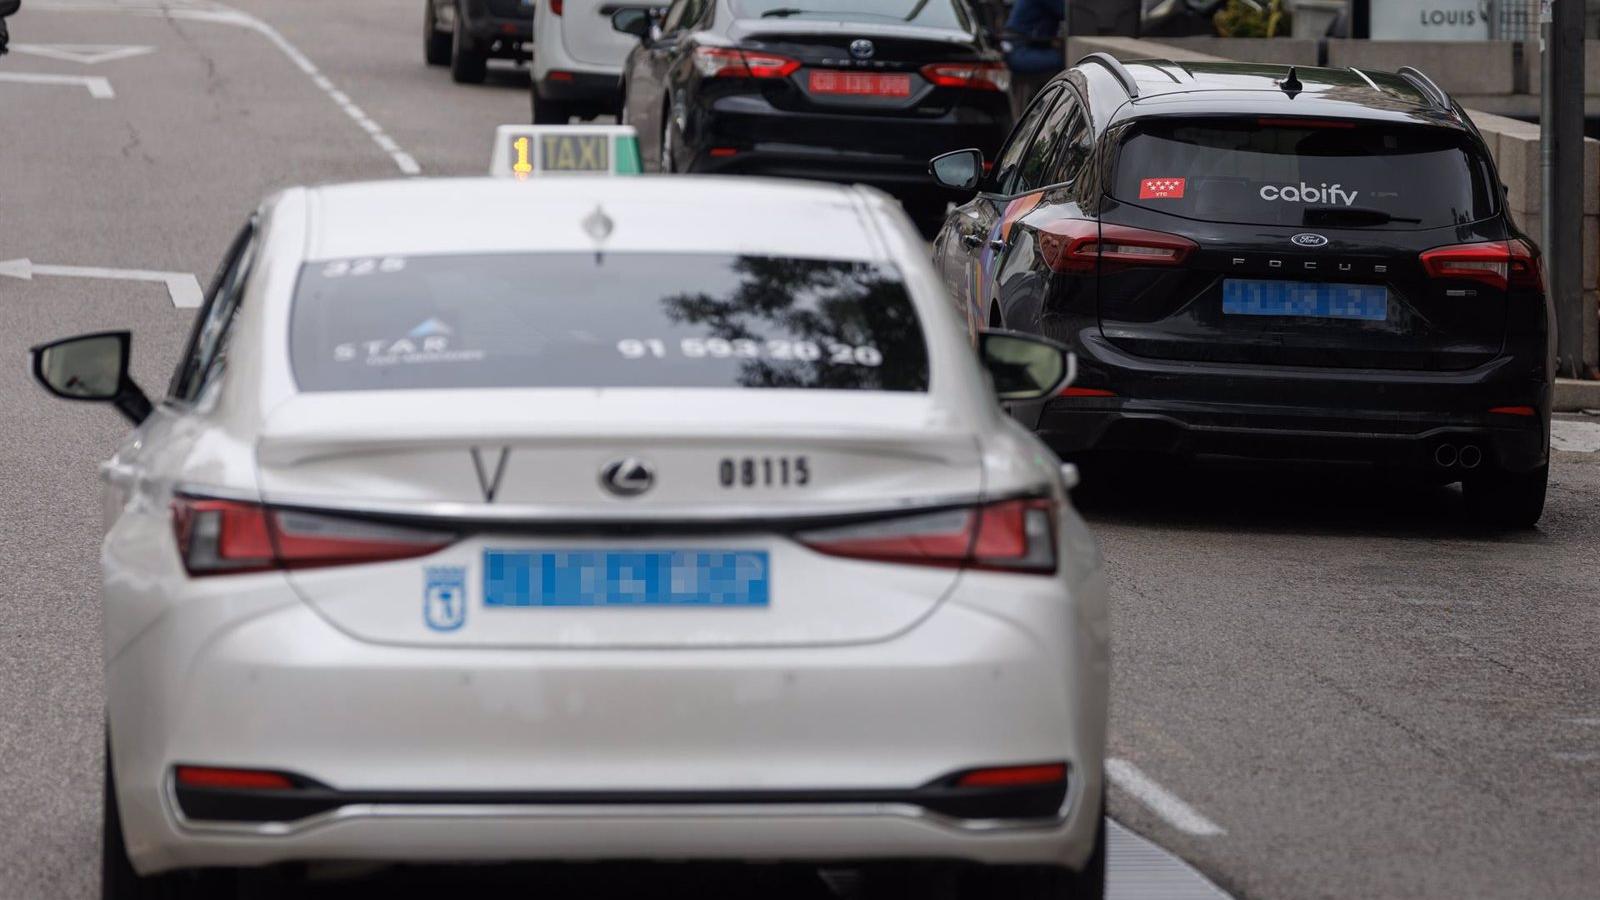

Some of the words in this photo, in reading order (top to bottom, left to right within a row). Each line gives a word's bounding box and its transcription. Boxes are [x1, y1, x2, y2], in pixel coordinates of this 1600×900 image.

[1421, 9, 1475, 25] LOUIS
[543, 135, 607, 170] TAXI
[1260, 182, 1357, 206] cabify
[1299, 235, 1321, 245] Ford
[1233, 258, 1387, 273] FOCUS
[334, 337, 448, 361] STAR
[617, 338, 665, 359] 91
[719, 457, 811, 487] 08115
